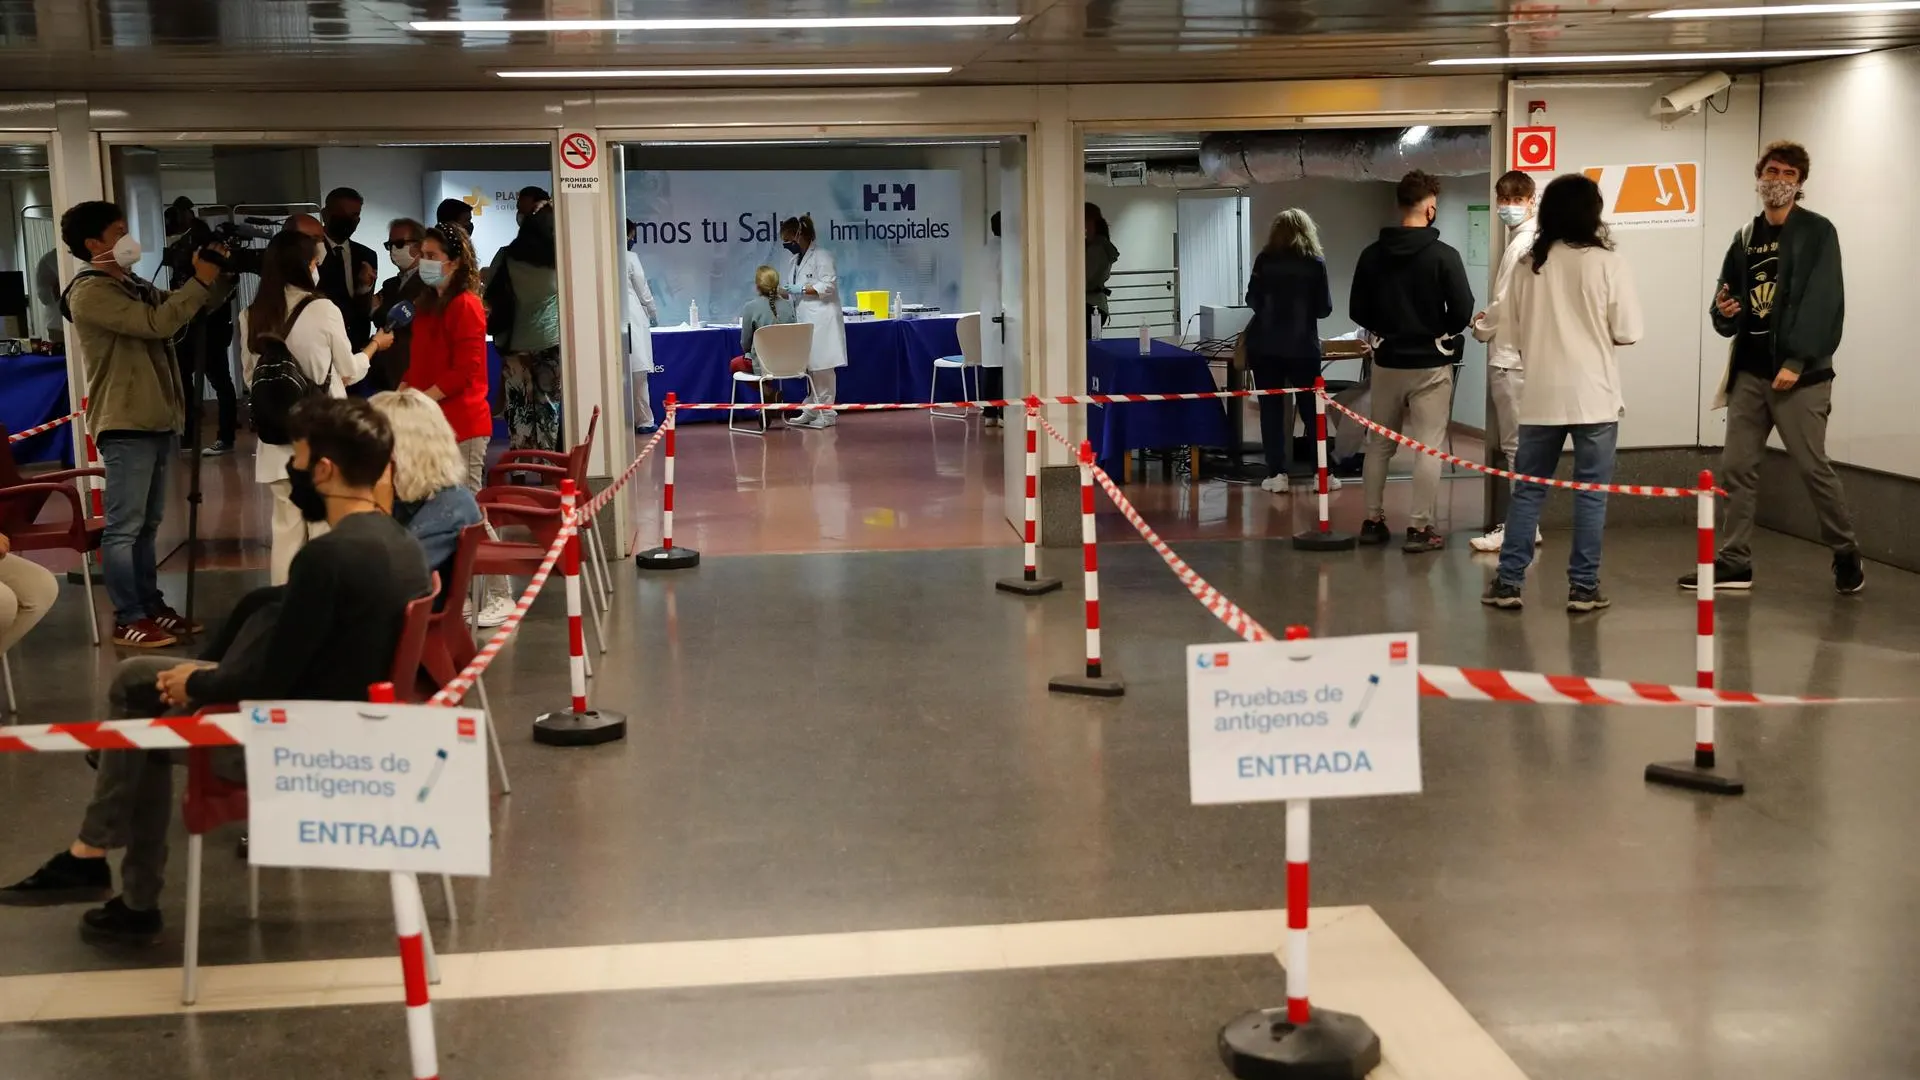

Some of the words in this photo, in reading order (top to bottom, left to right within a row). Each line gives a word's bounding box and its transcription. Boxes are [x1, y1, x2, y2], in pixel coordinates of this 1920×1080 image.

[863, 183, 917, 211] HM
[635, 220, 692, 244] mos
[701, 217, 728, 244] tu
[830, 219, 859, 241] hm
[865, 217, 950, 245] hospitales
[1213, 685, 1309, 709] Pruebas
[1314, 684, 1344, 704] de
[1213, 709, 1330, 734] antígenos
[273, 746, 374, 772] Pruebas
[379, 752, 411, 774] de
[1237, 750, 1373, 779] ENTRADA
[275, 770, 396, 799] antígenos
[298, 819, 441, 850] ENTRADA
